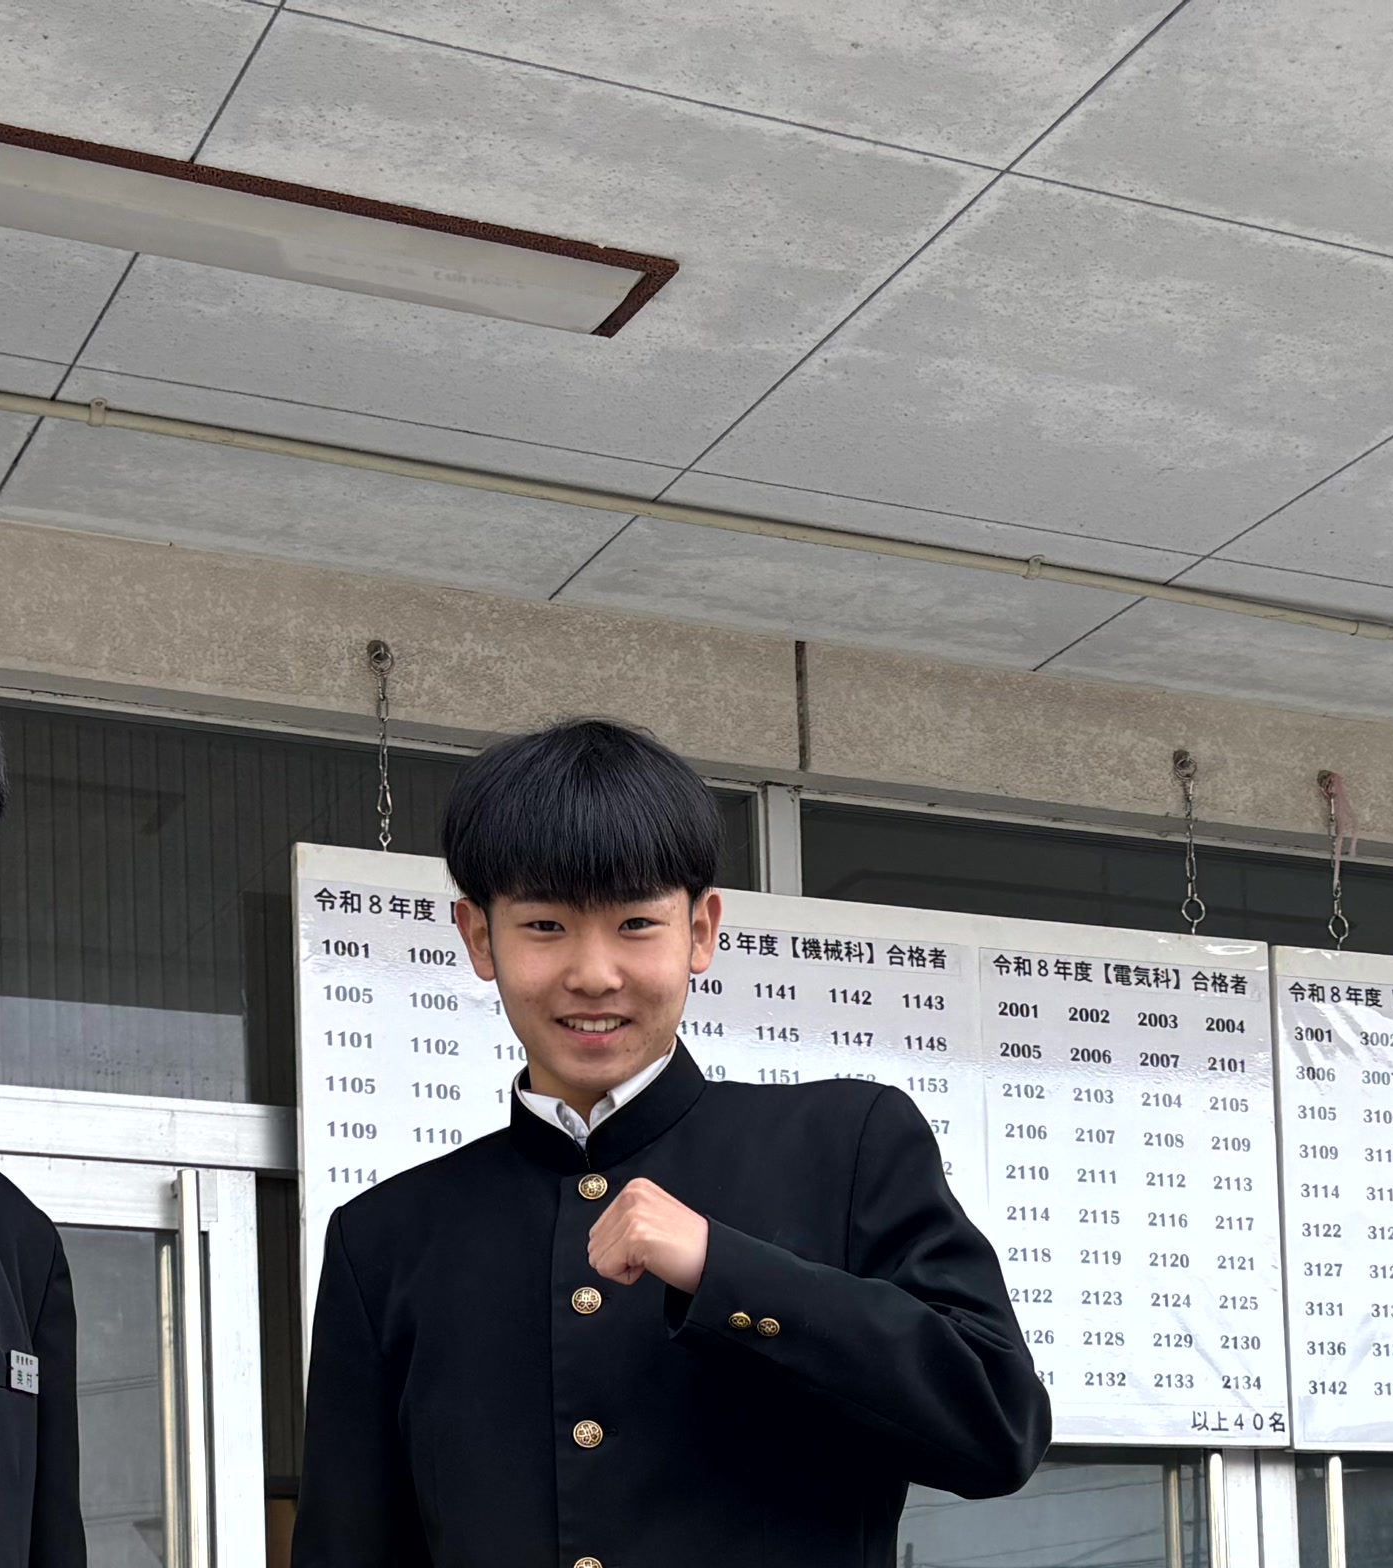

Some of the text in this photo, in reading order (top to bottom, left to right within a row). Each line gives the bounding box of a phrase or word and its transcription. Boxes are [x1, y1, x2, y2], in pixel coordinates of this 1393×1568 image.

[321, 938, 458, 967] 1001 1002
[718, 931, 947, 970] 8年度【機械科】合格者
[992, 953, 1248, 996] 令和8年度【電気科】合格者
[323, 984, 459, 1011] 1005 1006
[689, 978, 945, 1011] 140 1141 1142 1143
[998, 1001, 1246, 1034] 2001 2002 2003 2004
[324, 1029, 373, 1050] 1101
[410, 1036, 460, 1057] 1102
[681, 1020, 948, 1053] 1144 1145 1147 1148
[1294, 1025, 1333, 1044] 3001
[999, 1041, 1246, 1074] 2005 2006 2007 2101
[325, 1075, 461, 1101] 1105 1106
[758, 1068, 948, 1094] 1151 1153
[1001, 1082, 1249, 1113] 2102 2103 2104 2105
[1297, 1104, 1337, 1122] 3105
[326, 1120, 463, 1146] 1109 1110
[1004, 1122, 1251, 1153] 2106 2107 2108 2109
[1298, 1143, 1339, 1161] 3109
[328, 1167, 378, 1185] 1114
[1005, 1164, 1253, 1192] 2110 2111 2112 2113
[1300, 1182, 1340, 1199] 3114
[1006, 1205, 1255, 1232] 2114 2115 2116 2117
[1301, 1222, 1342, 1239] 3122
[1007, 1246, 1255, 1271] 2118 2119 2120 2121
[1303, 1261, 1343, 1278] 3127
[1010, 1288, 1259, 1311] 2122 2123 2124 2125
[1305, 1300, 1343, 1317] 3131
[1023, 1329, 1261, 1351] 126 2128 2129 2130
[1306, 1340, 1347, 1356] 3136
[1084, 1371, 1262, 1391] 2132 2133 2134
[1308, 1379, 1348, 1396] 3142
[1191, 1410, 1286, 1433] 以上40名
